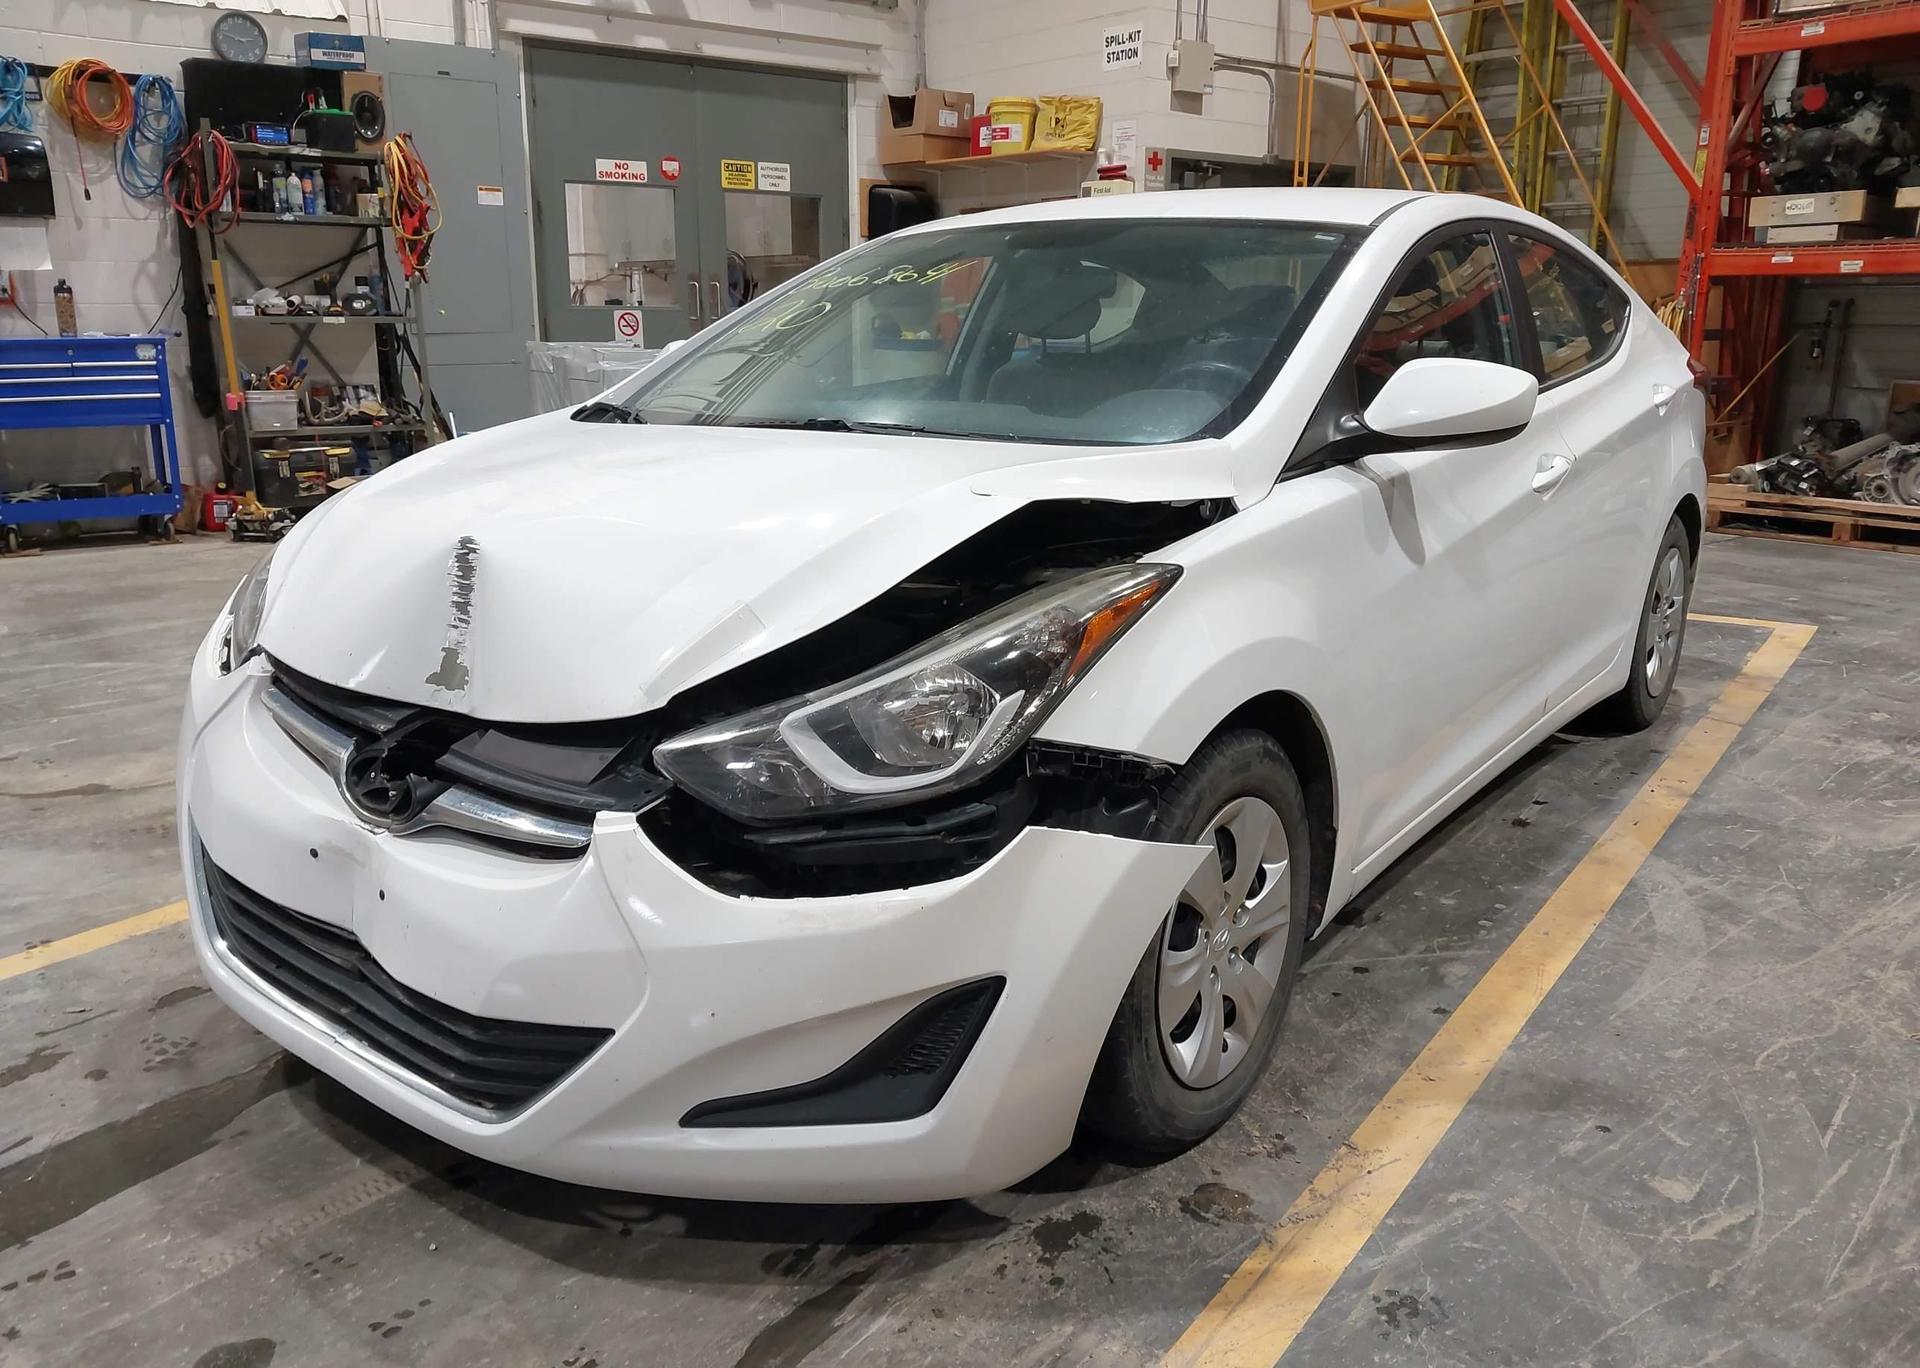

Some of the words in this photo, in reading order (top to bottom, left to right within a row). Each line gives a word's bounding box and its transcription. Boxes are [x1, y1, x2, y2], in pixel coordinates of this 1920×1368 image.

[1105, 30, 1142, 48] SPILL-KIT
[1106, 46, 1139, 64] STATION
[614, 162, 629, 170] NO
[724, 163, 752, 173] CAUTION
[598, 170, 646, 181] SMOKING
